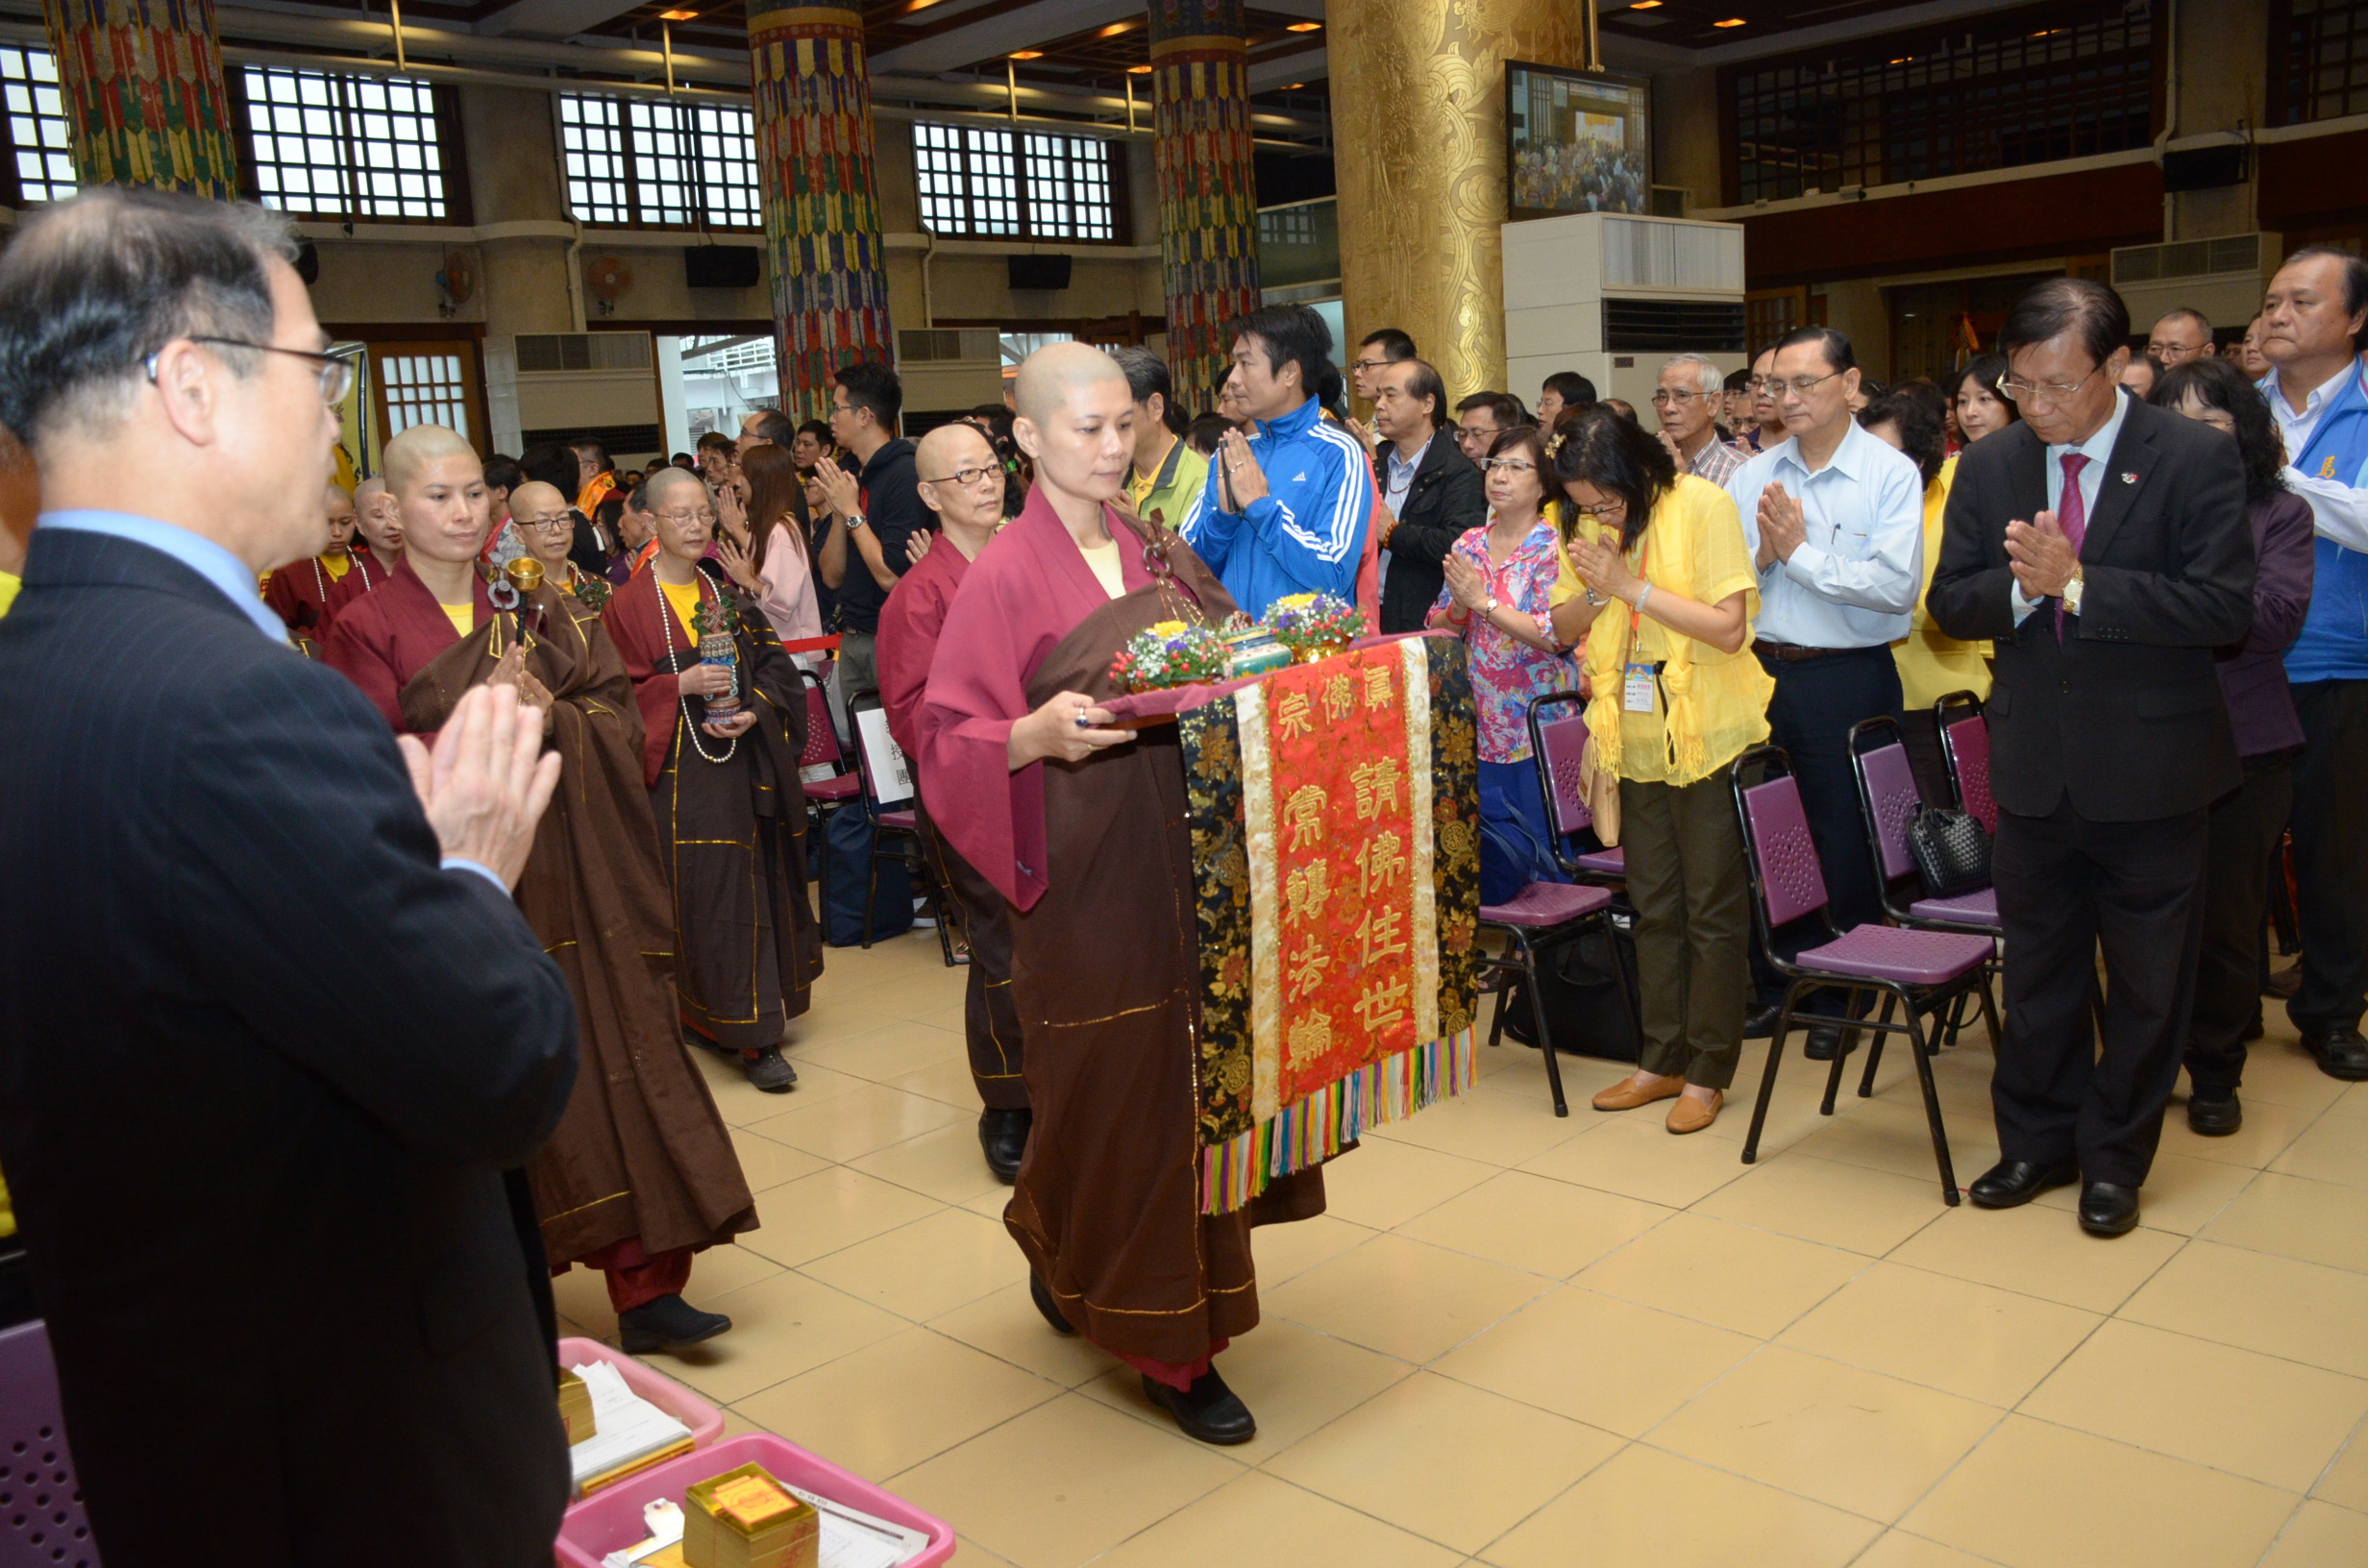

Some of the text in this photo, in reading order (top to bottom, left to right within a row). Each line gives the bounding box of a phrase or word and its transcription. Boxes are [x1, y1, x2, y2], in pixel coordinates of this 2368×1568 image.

[1283, 784, 1332, 1073] 常轉法輪
[1350, 755, 1408, 1032] 請佛住世
